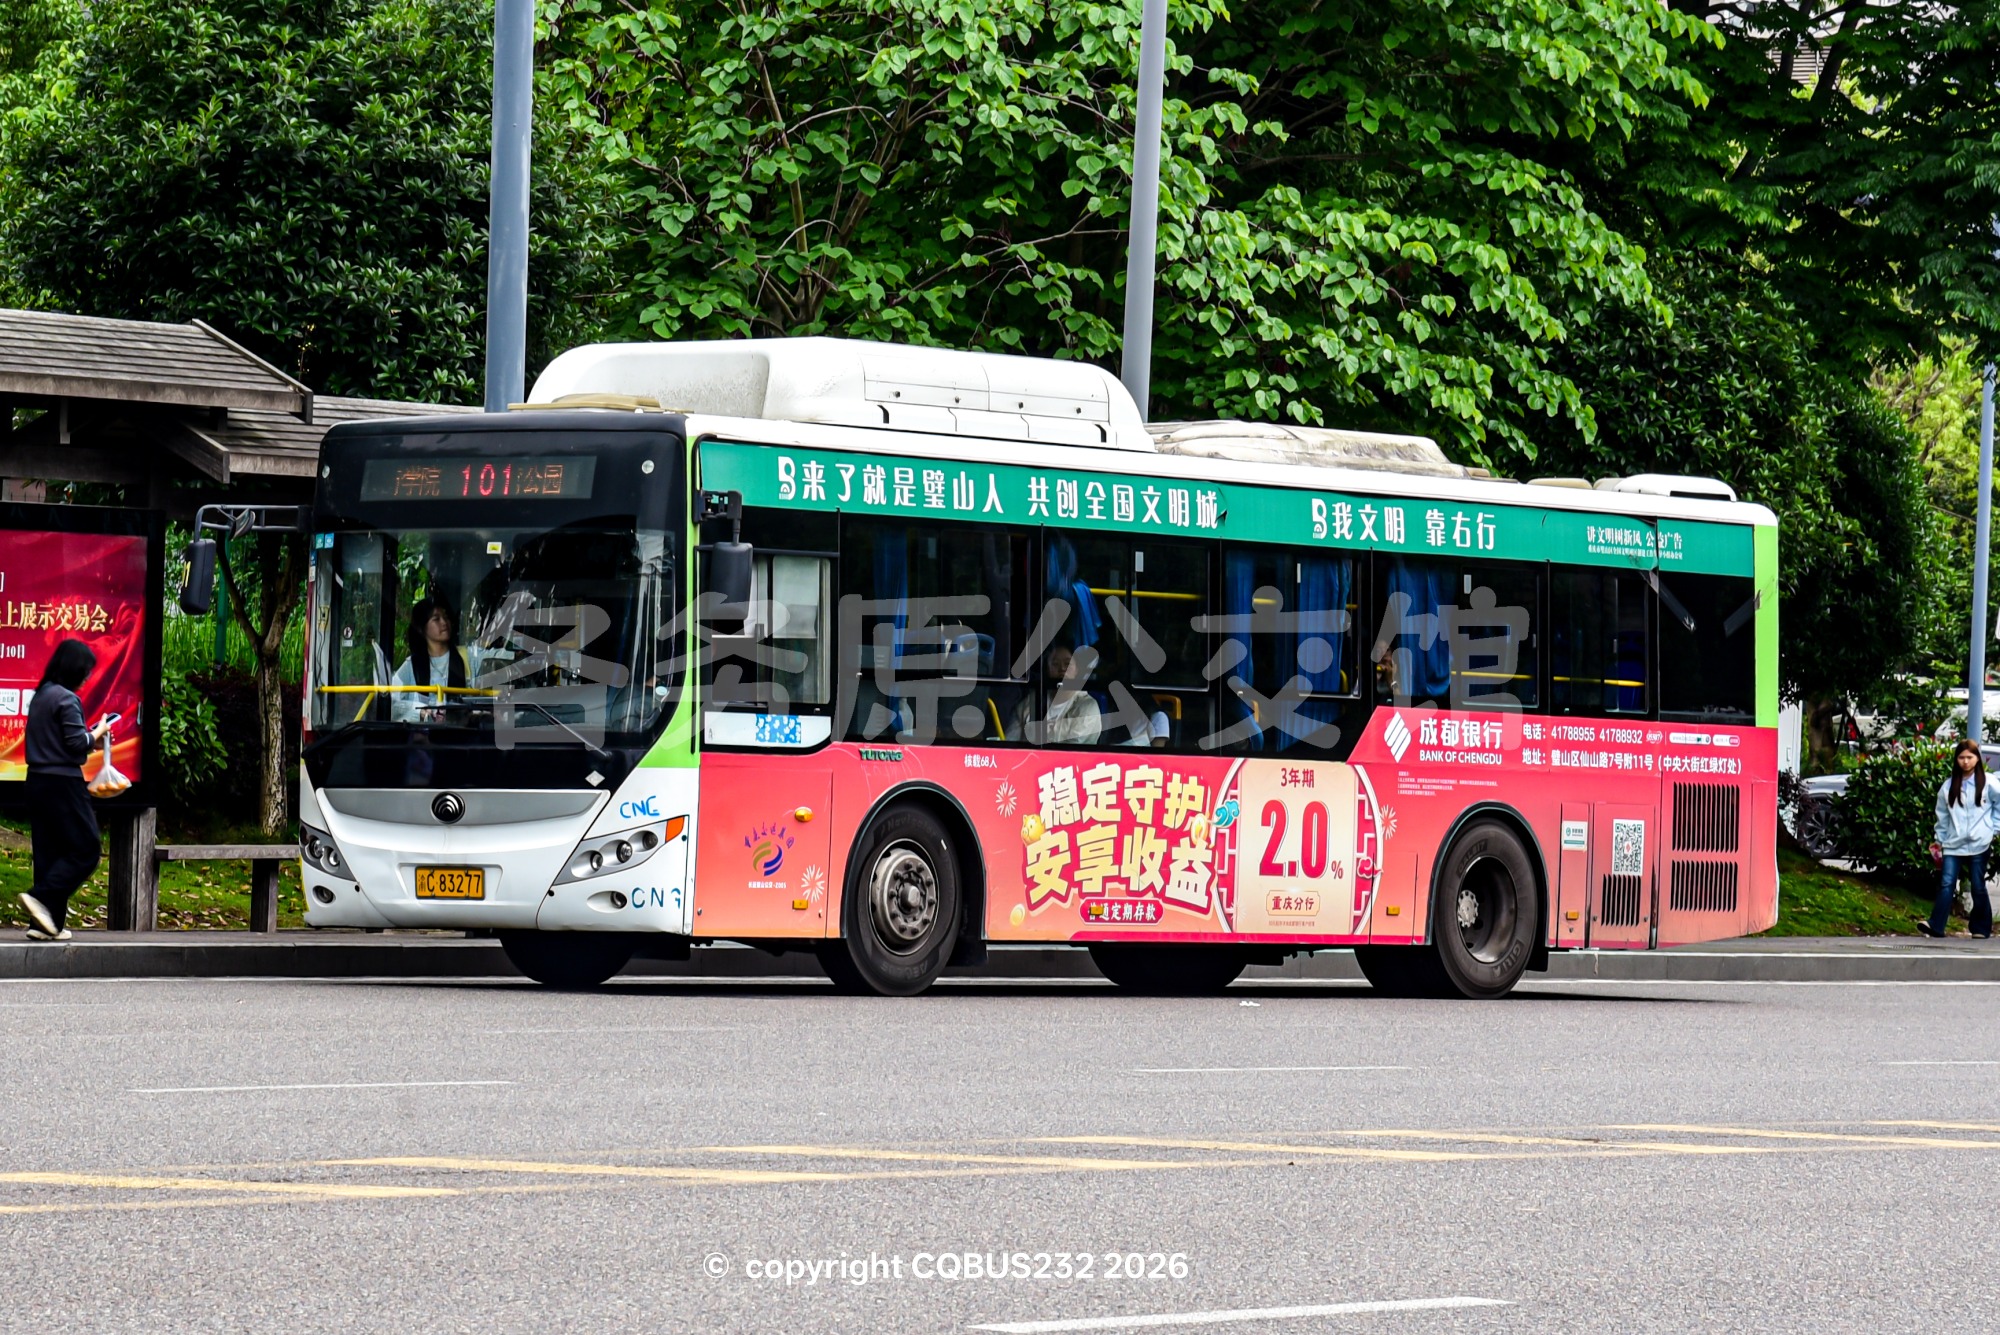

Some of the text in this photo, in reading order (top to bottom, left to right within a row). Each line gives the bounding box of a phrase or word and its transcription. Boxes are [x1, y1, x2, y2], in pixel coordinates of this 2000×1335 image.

[461, 463, 511, 496] 101
[802, 460, 1004, 514] 来了就是璧山人
[1027, 476, 1218, 529] 共创全国文明城
[1332, 501, 1405, 544] 我文明
[1425, 508, 1496, 550] 靠右行
[0, 600, 114, 633] 上展示交易会·
[1419, 717, 1502, 749] 成都银行
[1599, 729, 1643, 744] 41788932
[859, 747, 903, 761] YUTONG
[1420, 749, 1502, 765] BANK OF CHENGDU
[1281, 768, 1315, 788] 3年期
[1038, 761, 1205, 832] 稳定守护
[1026, 823, 1213, 909] 安享收益
[1272, 895, 1315, 911] 重庆分行
